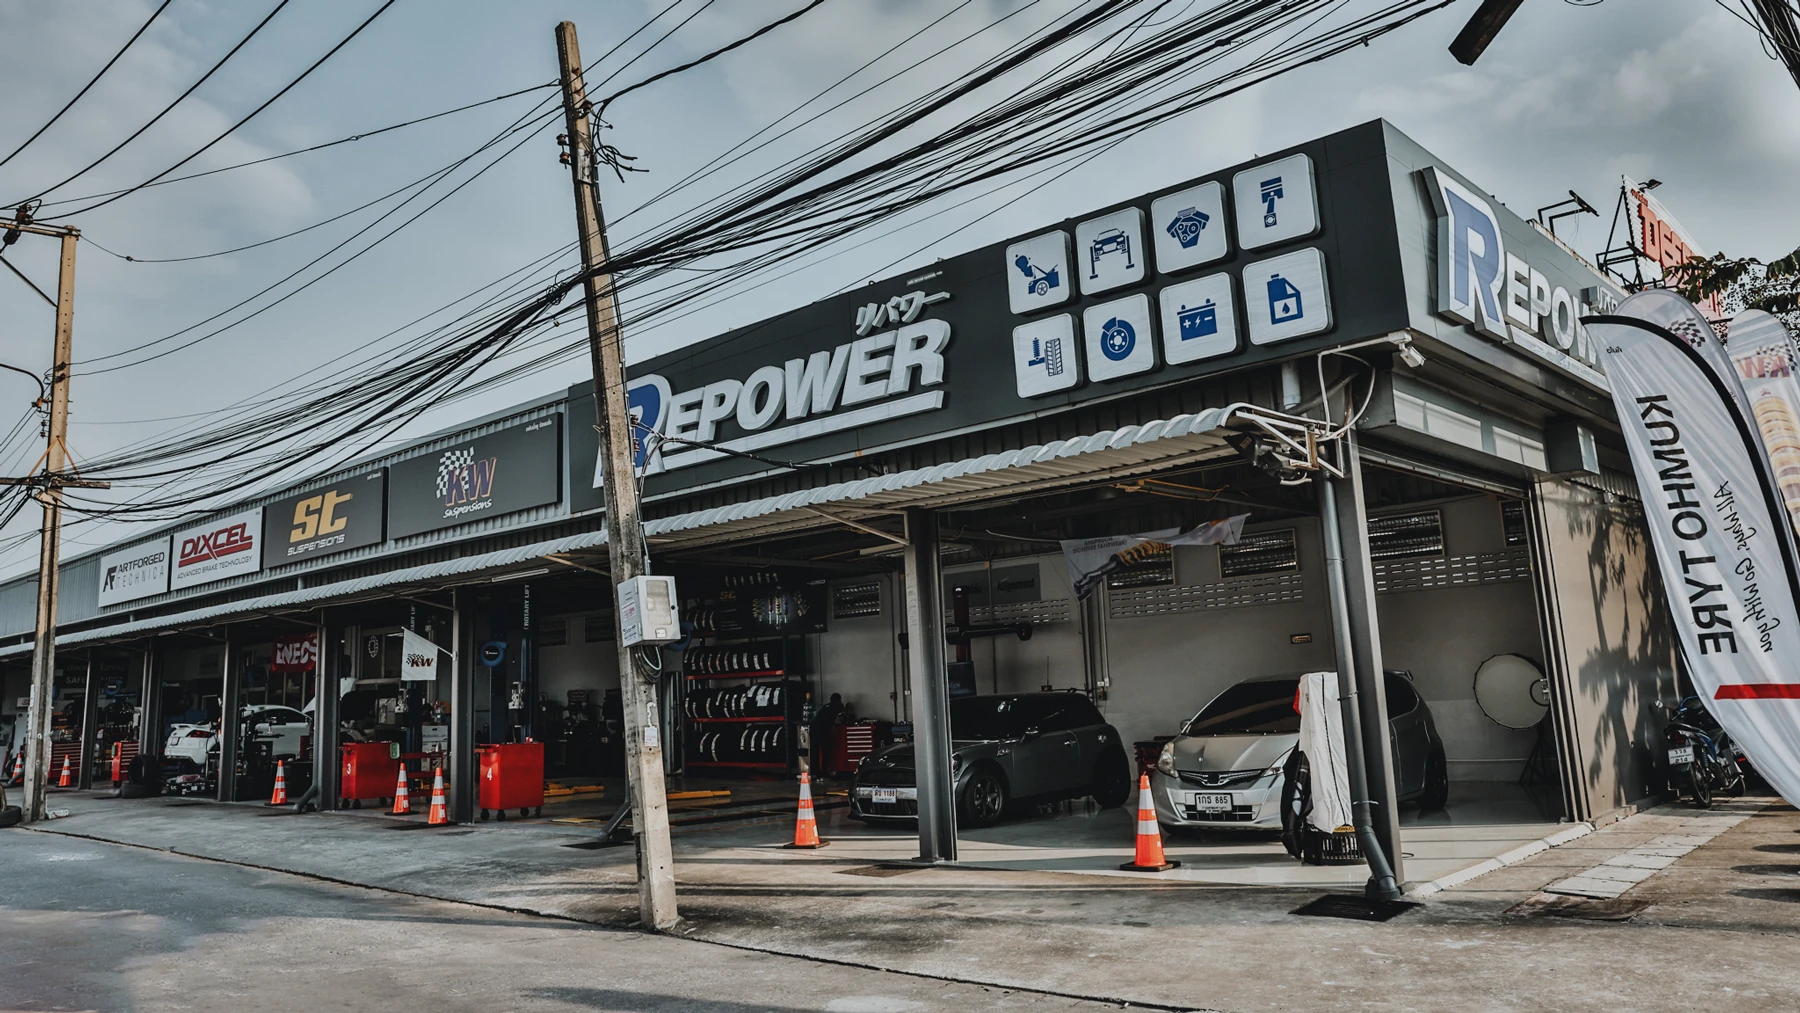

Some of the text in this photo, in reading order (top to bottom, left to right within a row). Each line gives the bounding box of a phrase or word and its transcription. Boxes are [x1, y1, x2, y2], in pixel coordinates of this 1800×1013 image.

[856, 290, 951, 336] リパワー
[592, 318, 951, 488] REPOWER
[444, 456, 497, 507] KW
[180, 522, 253, 560] DIXCEL
[117, 551, 165, 574] ARTFORGED
[177, 555, 253, 579] ADVANCED BRAKE TECHNOLOGY
[116, 564, 165, 588] TECHNICA
[410, 656, 434, 668] KW
[65, 676, 87, 684] SAFE
[346, 763, 352, 775] 3
[486, 767, 493, 781] 4
